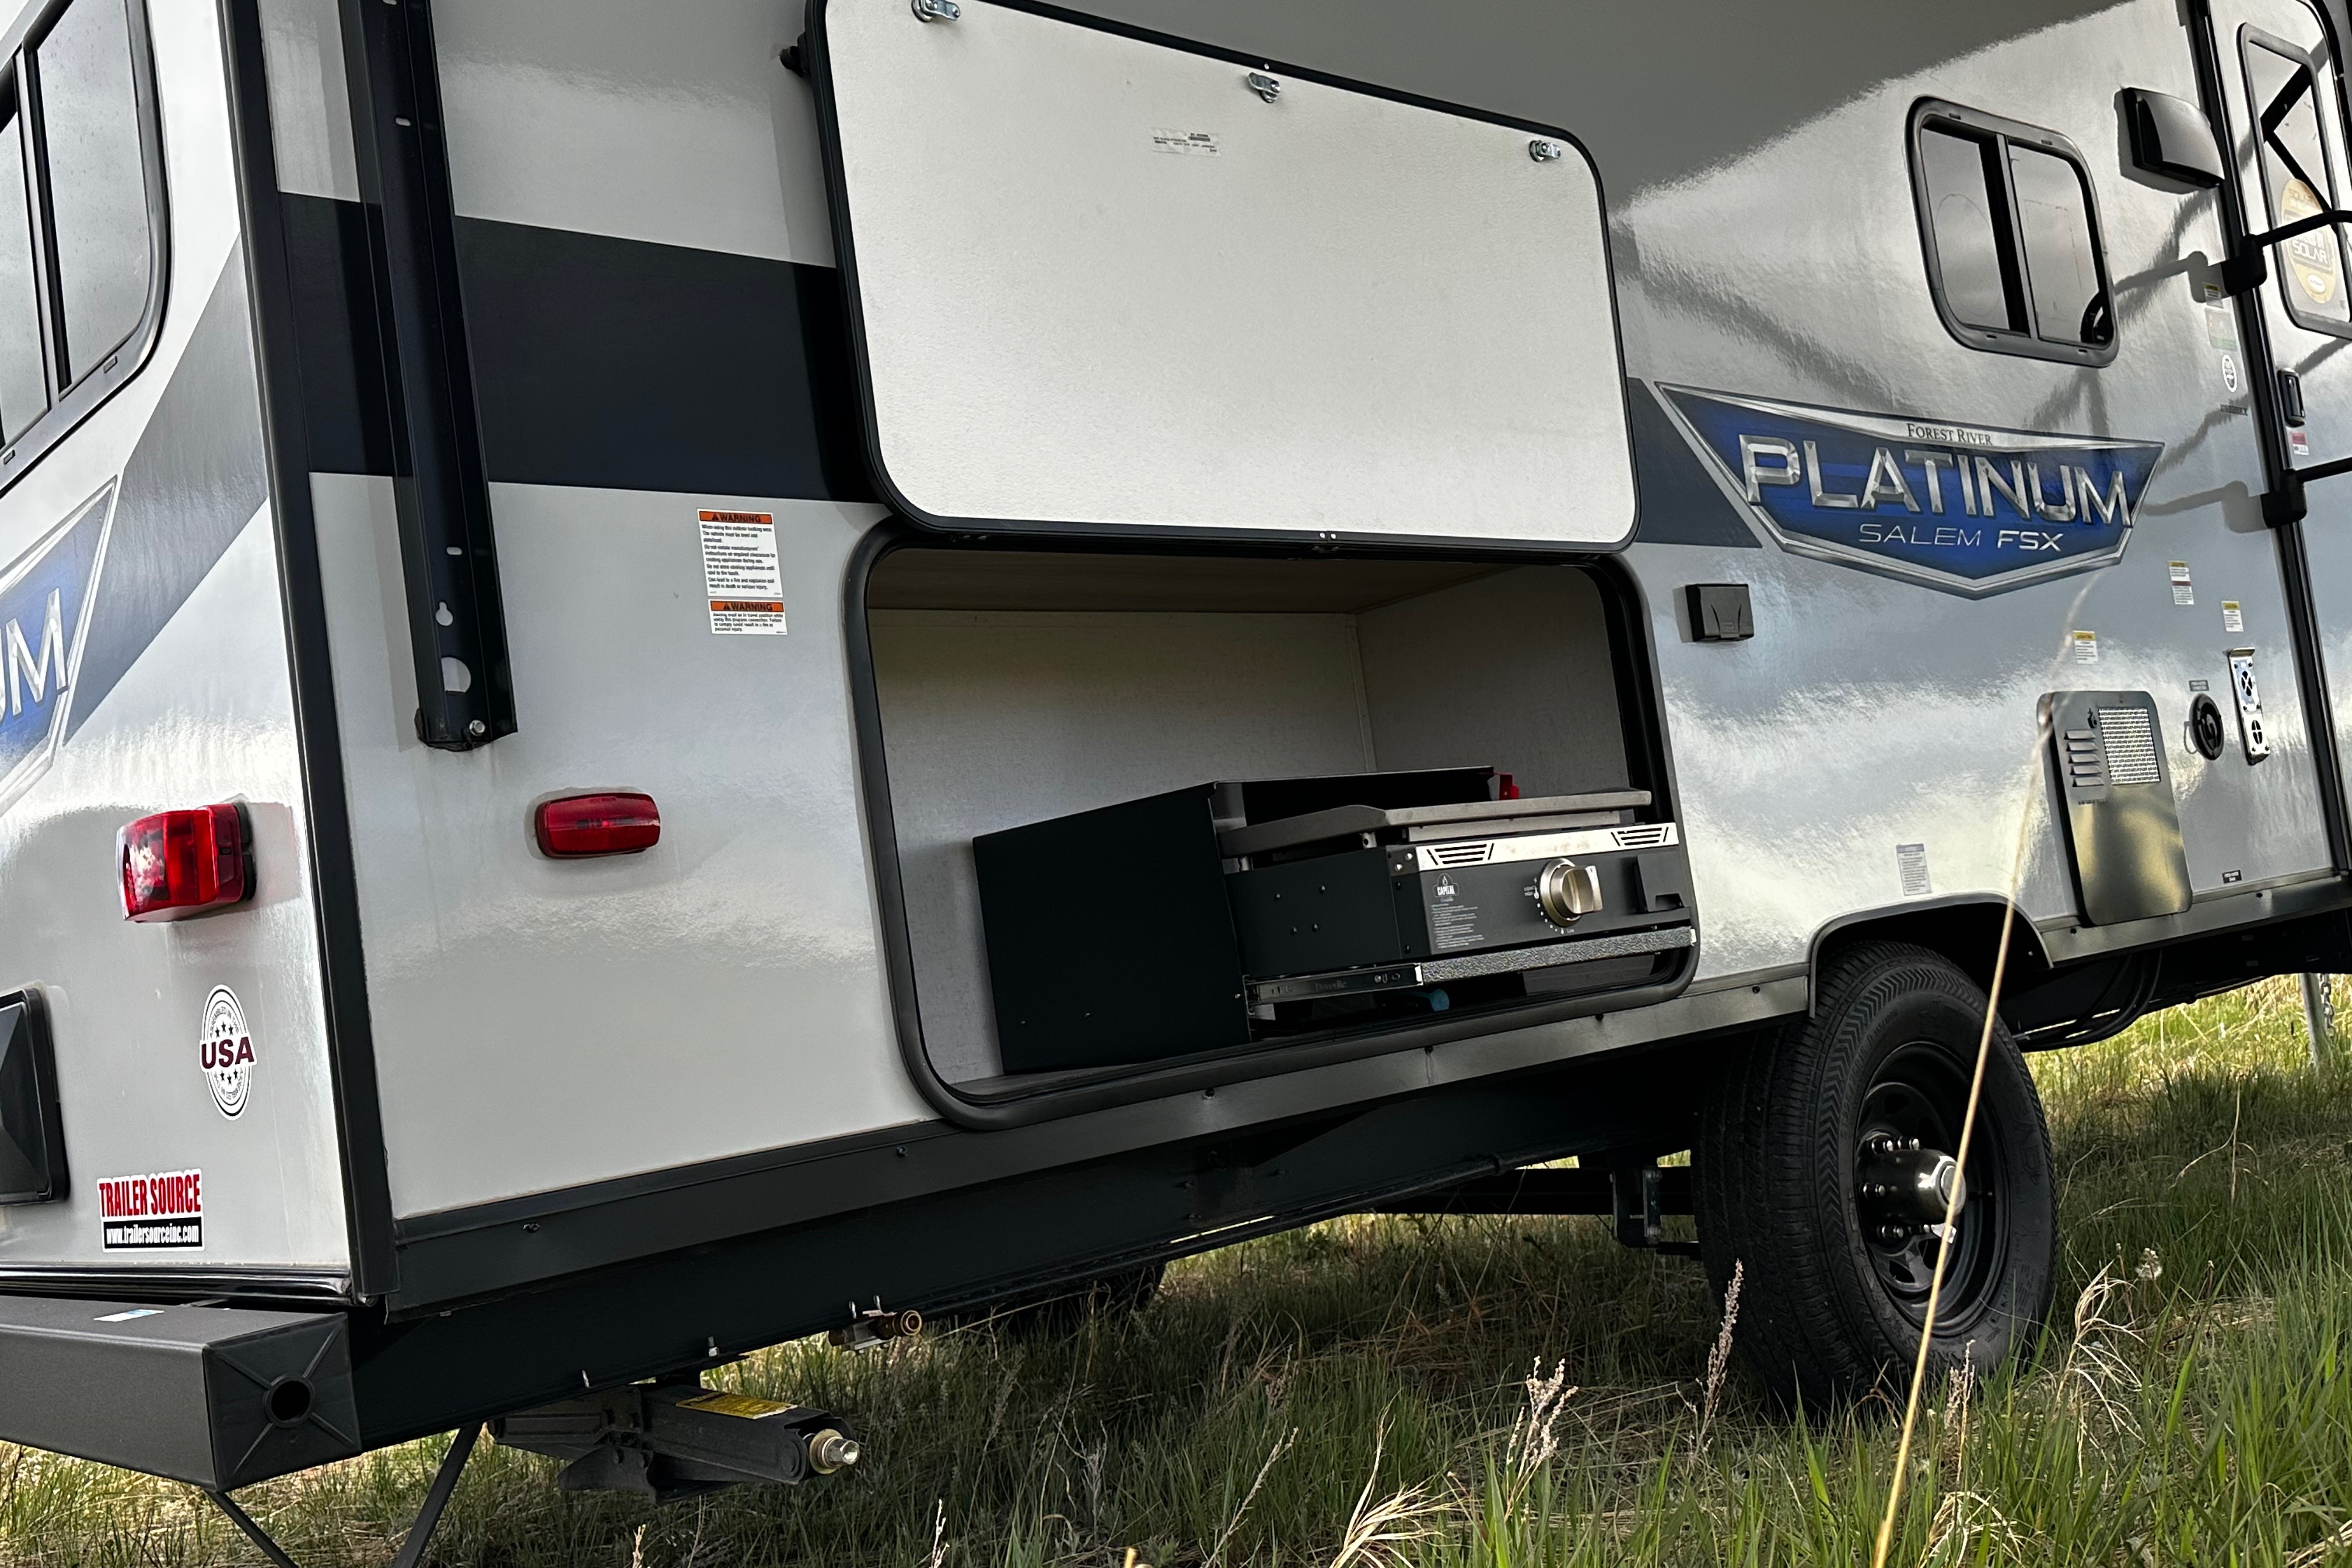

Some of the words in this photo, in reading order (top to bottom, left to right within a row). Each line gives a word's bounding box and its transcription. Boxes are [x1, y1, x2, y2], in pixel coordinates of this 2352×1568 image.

[2292, 242, 2328, 264] SOLAR
[1906, 423, 1954, 442] FOREST
[1957, 429, 1993, 446] RIVER
[1738, 433, 2133, 527] PLATINUM
[720, 514, 761, 523] WARNING
[1859, 523, 1982, 547] SALEM
[1997, 530, 2064, 552] FSX
[731, 603, 773, 611] WARNING
[0, 587, 66, 723] M
[1437, 885, 1455, 896] CAPITAL
[201, 1036, 254, 1069] USA
[99, 1180, 148, 1217] TRAILER
[150, 1174, 201, 1215] SOURCE
[106, 1223, 200, 1244] www.trailersourceinc.com
